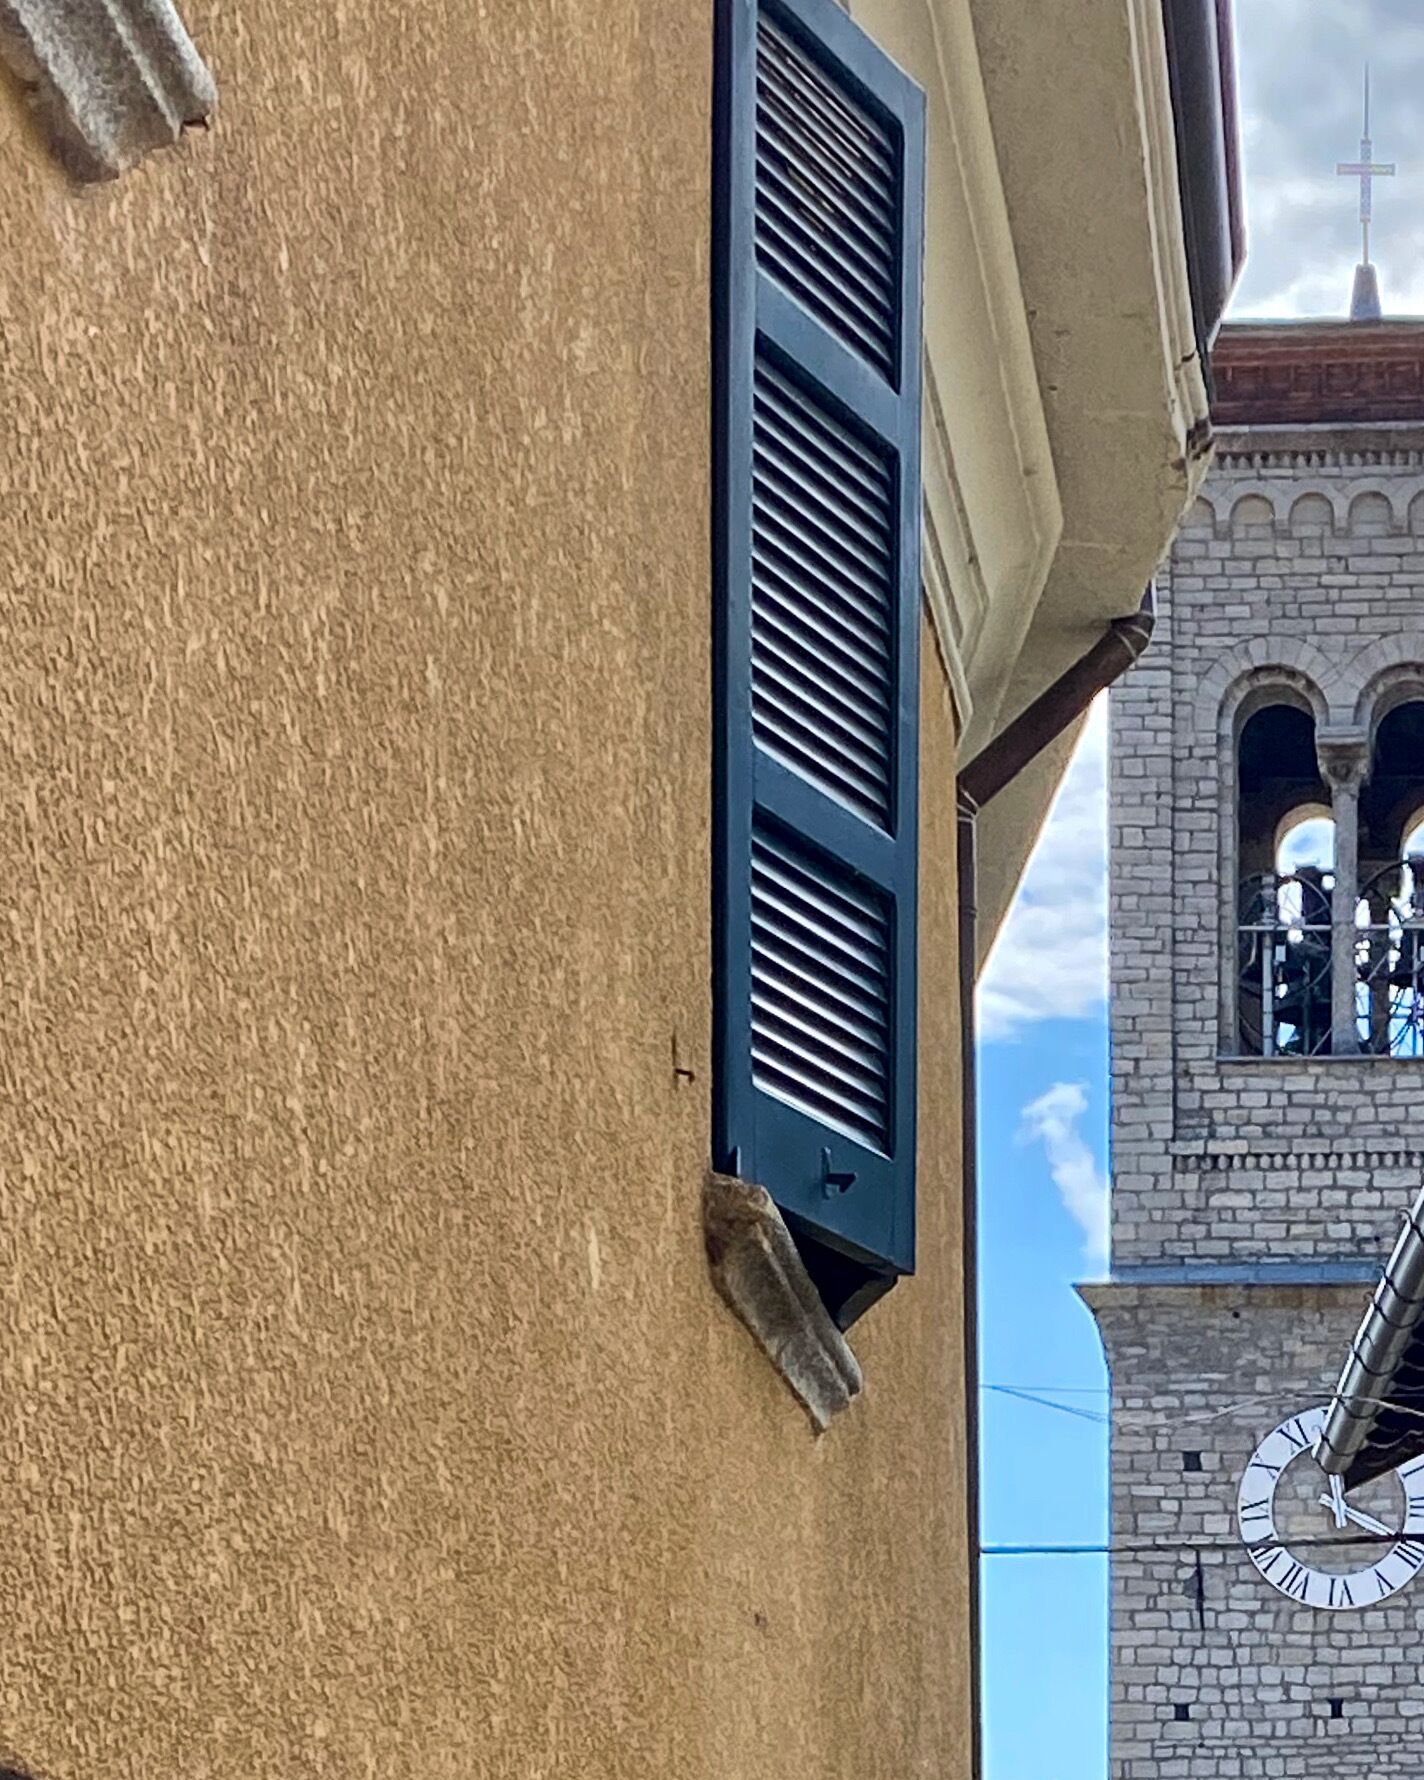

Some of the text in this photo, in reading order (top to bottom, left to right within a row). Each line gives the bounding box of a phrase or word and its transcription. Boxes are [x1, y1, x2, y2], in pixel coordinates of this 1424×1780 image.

[1276, 1417, 1311, 1456] XI
[1249, 1452, 1282, 1480] X
[1240, 1497, 1270, 1524] IX
[1276, 1561, 1310, 1600] VII
[1327, 1577, 1355, 1608] VI
[1373, 1568, 1396, 1598] V
